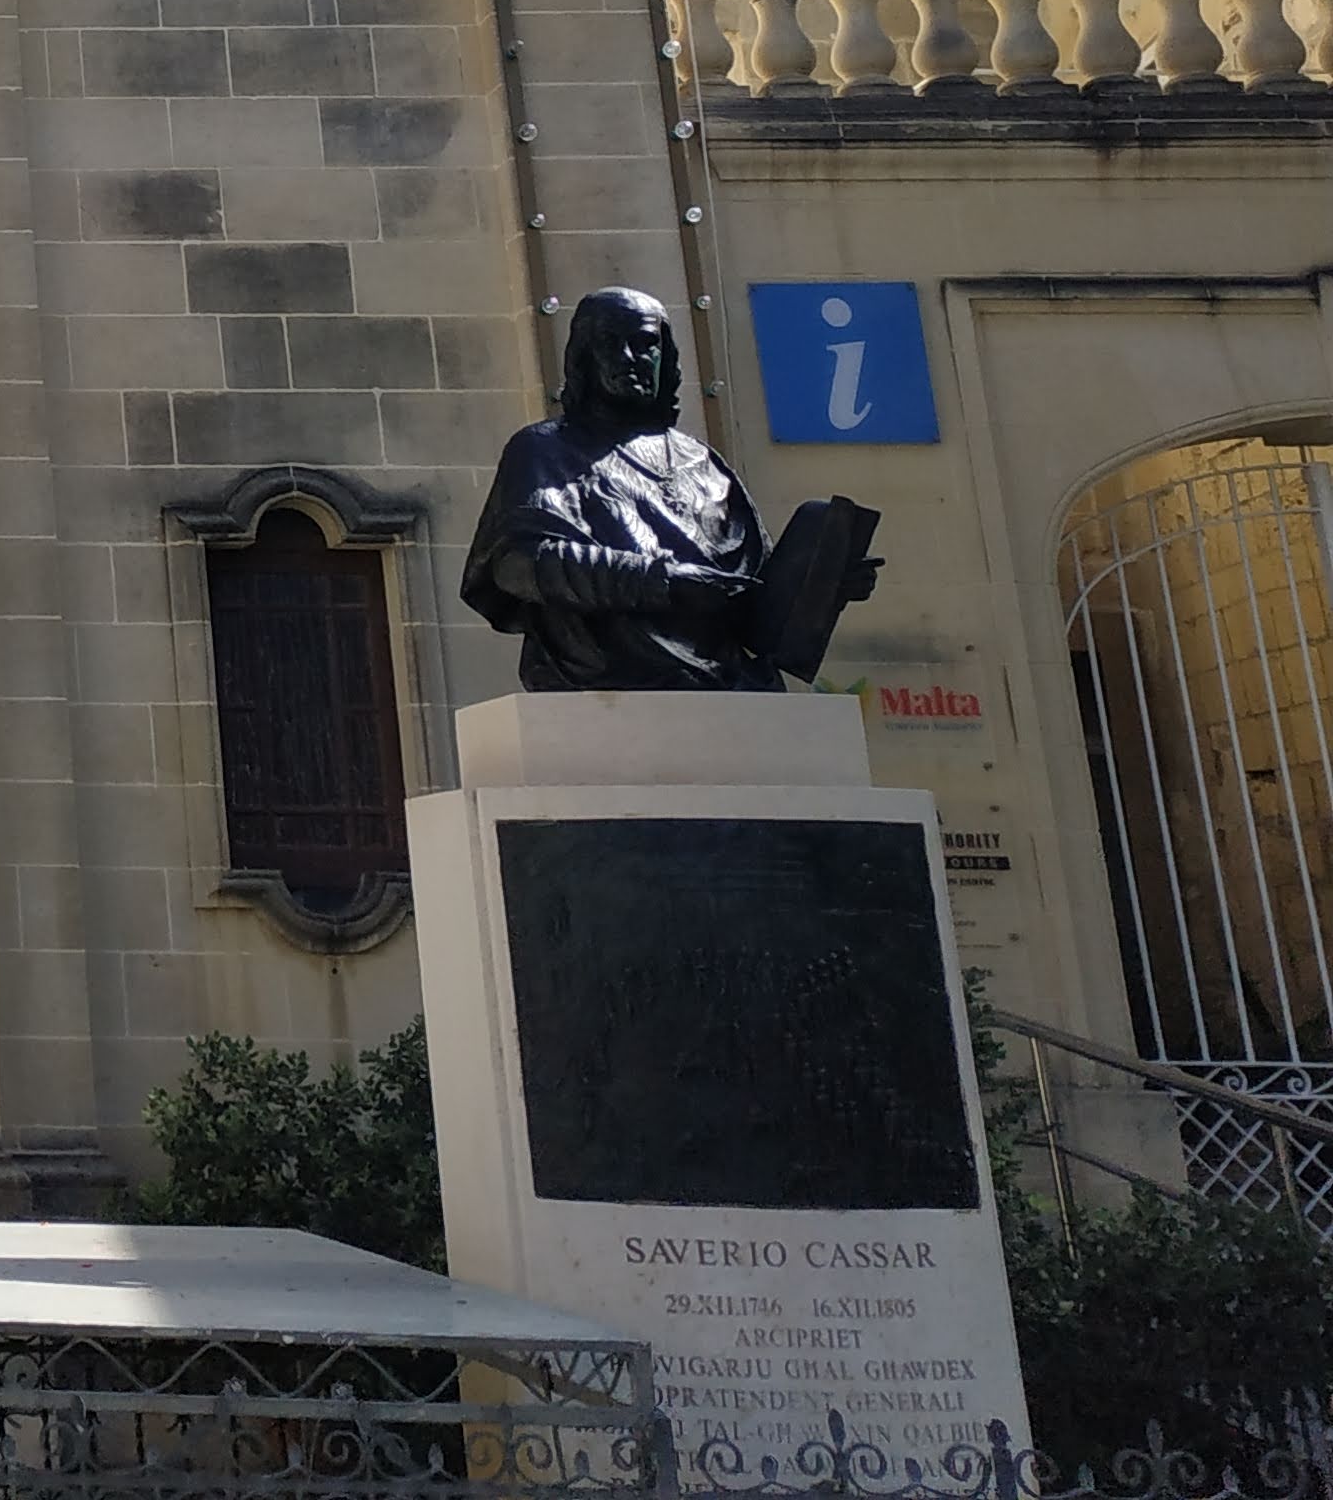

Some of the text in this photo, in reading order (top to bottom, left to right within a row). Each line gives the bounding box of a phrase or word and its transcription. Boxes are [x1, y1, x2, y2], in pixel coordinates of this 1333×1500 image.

[880, 686, 982, 717] Malta
[940, 832, 1000, 849] HORITY
[949, 857, 999, 869] OURS
[625, 1236, 938, 1269] SAVERIO CASSAR
[733, 1326, 863, 1350] ARCIPRIET
[845, 1389, 966, 1413] GENERALI
